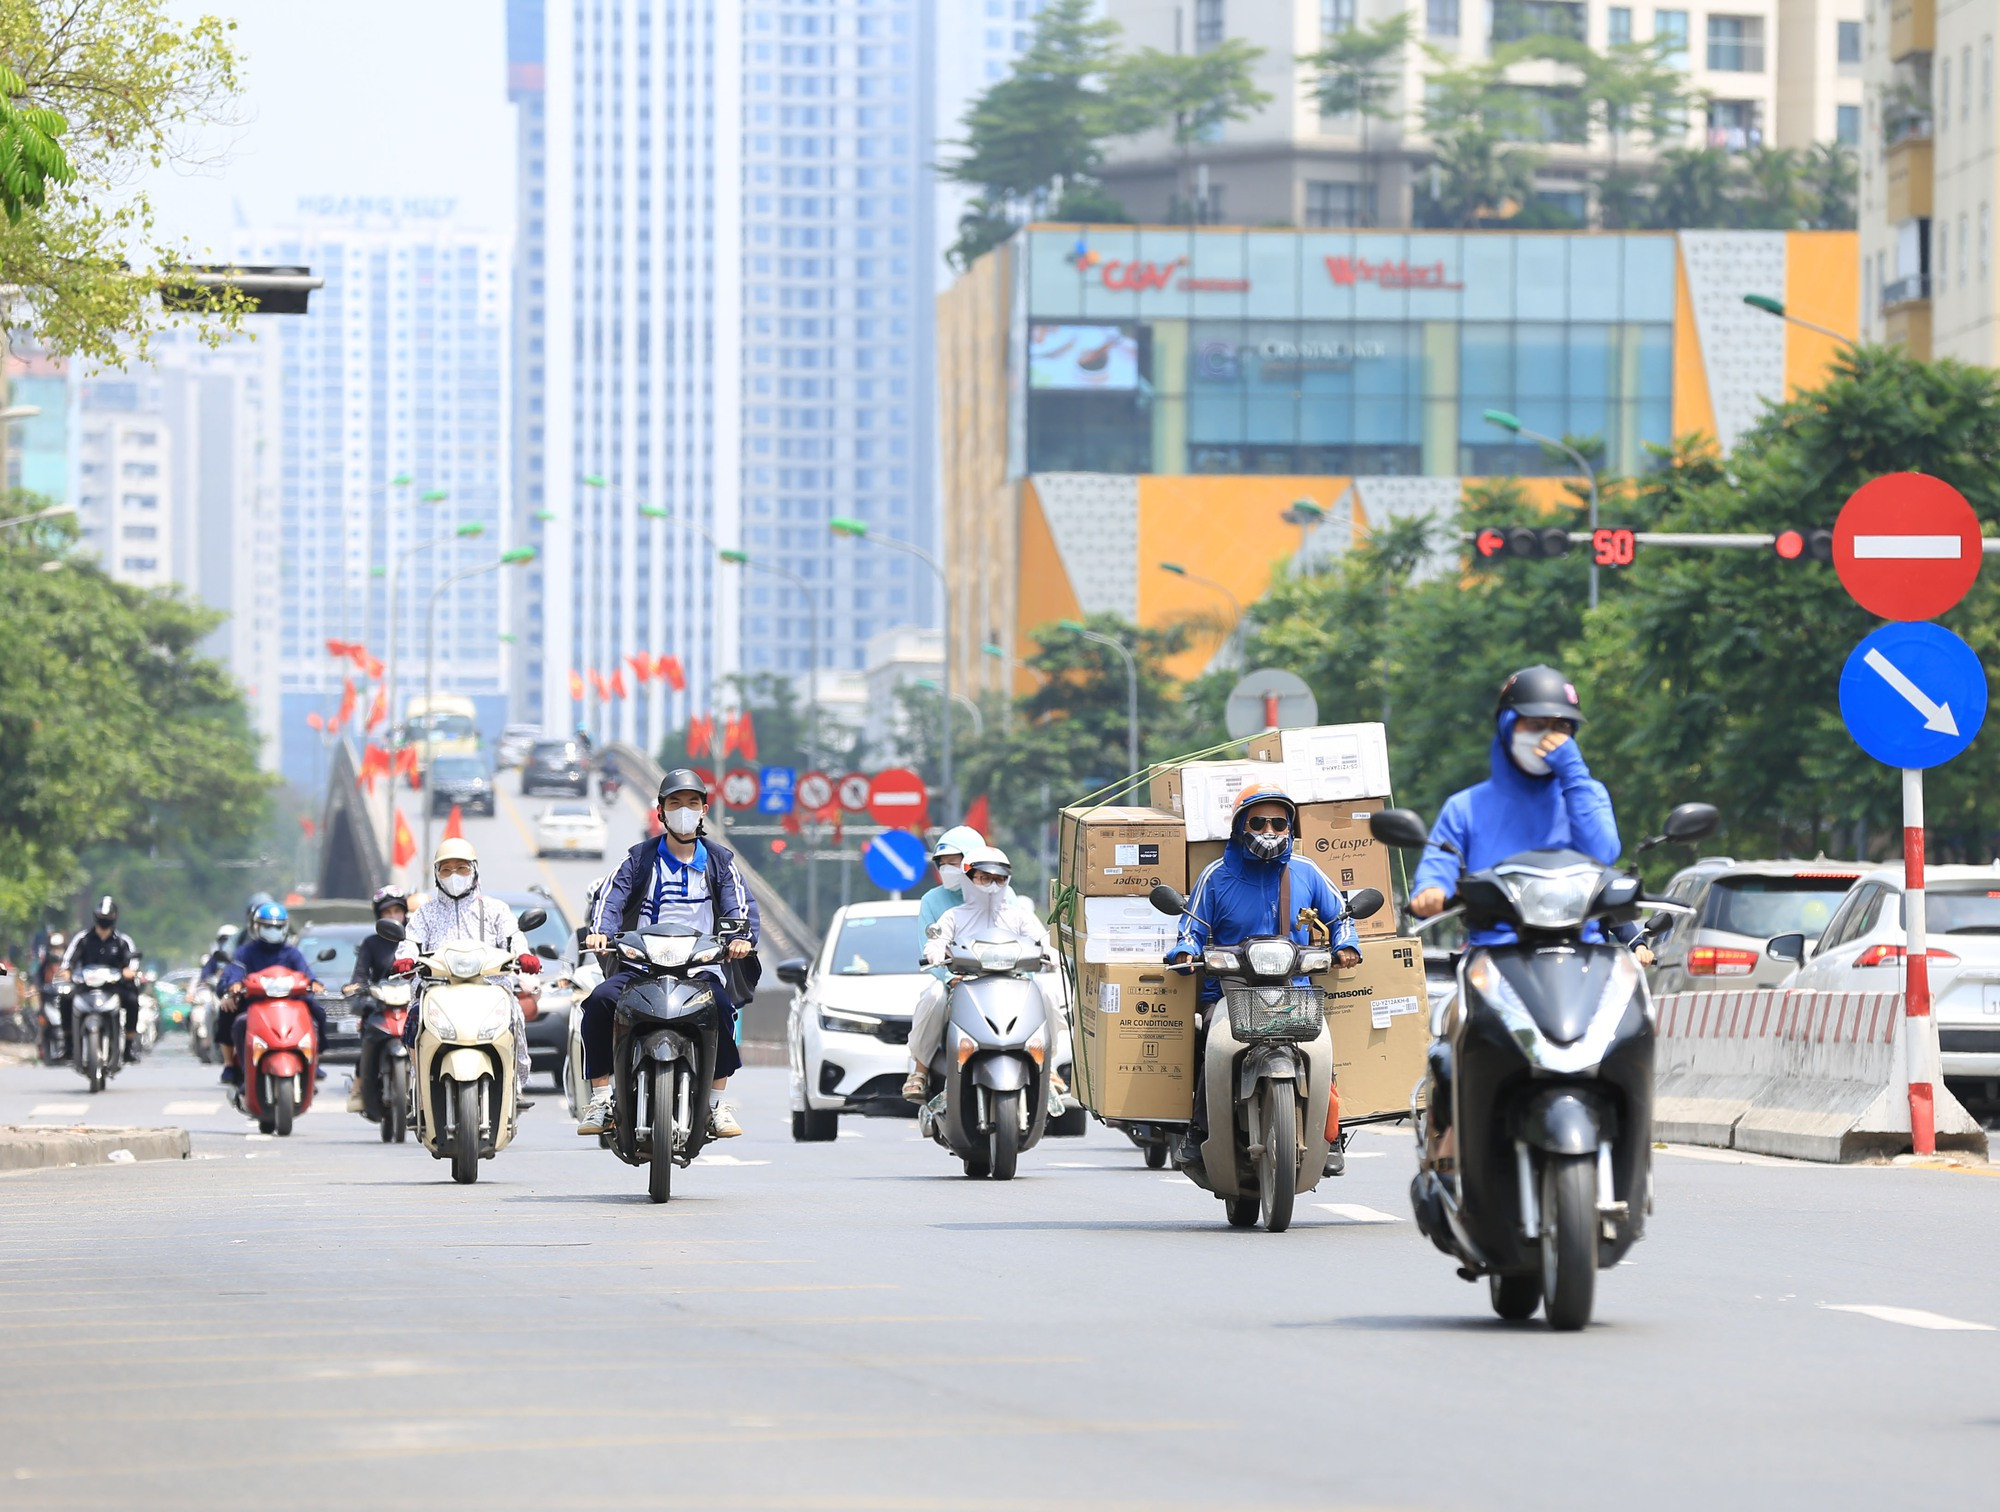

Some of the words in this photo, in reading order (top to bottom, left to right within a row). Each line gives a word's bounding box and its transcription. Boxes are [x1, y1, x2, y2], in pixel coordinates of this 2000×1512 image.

[1593, 529, 1634, 565] 50
[1331, 838, 1376, 850] Casper
[1343, 872, 1352, 880] 12
[1113, 877, 1149, 888] Casper
[1151, 1003, 1166, 1013] LG
[1133, 1019, 1183, 1028] CONDITIONER
